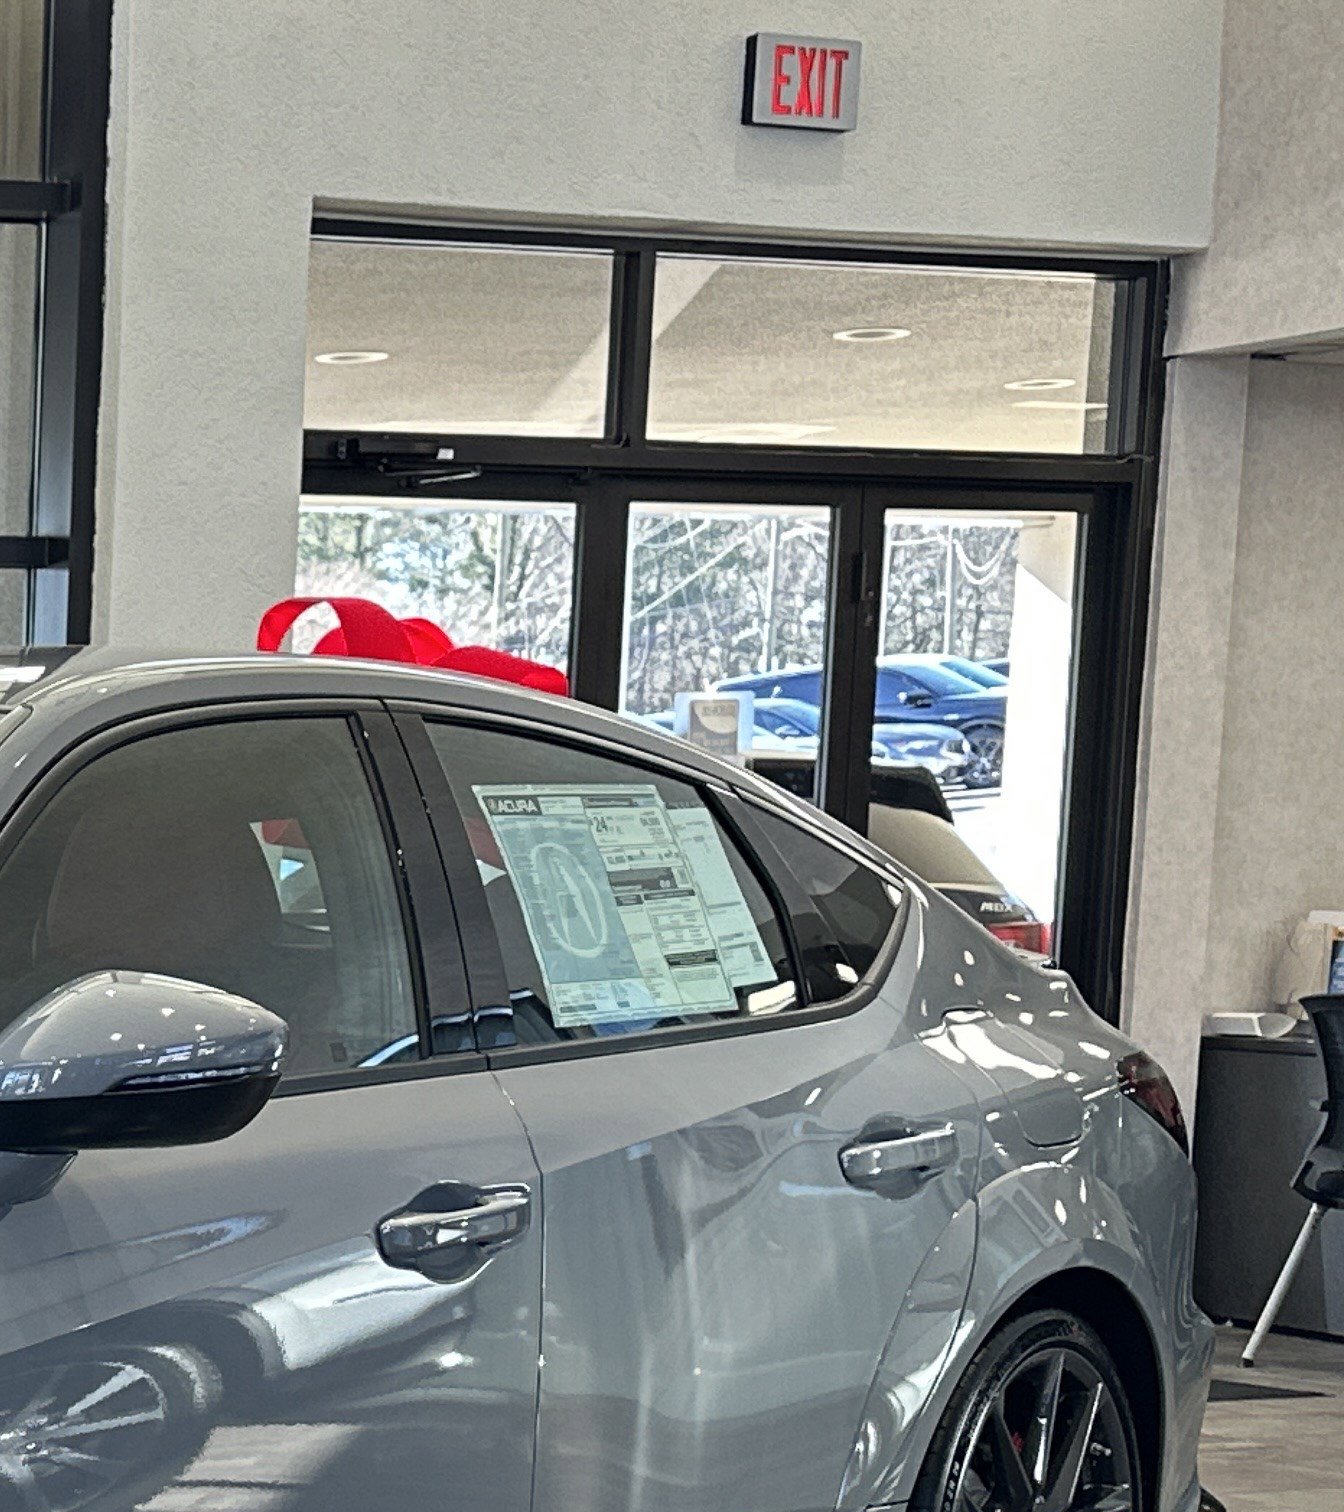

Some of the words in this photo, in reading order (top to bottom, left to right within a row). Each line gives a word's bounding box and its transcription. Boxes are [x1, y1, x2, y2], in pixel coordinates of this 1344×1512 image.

[771, 44, 849, 119] EXIT
[496, 799, 539, 813] ACURA
[979, 901, 1013, 913] MDX
